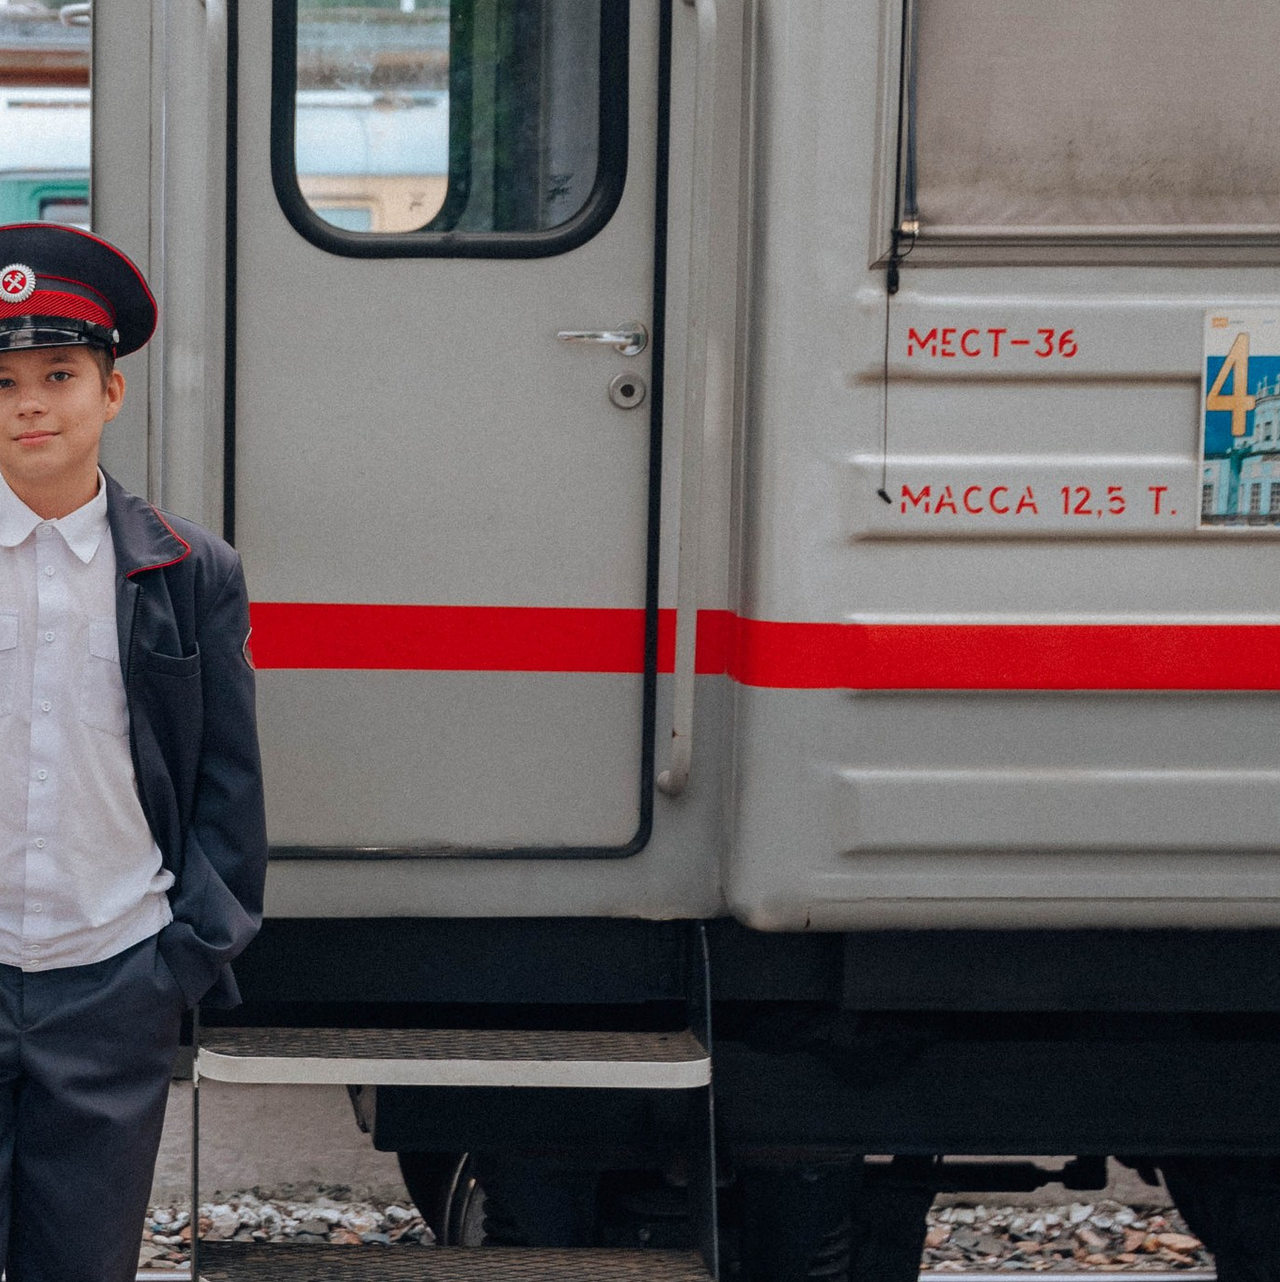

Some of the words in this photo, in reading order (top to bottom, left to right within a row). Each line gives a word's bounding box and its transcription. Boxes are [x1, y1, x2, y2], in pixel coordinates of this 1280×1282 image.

[906, 327, 1080, 359] МЕСТ-36
[1206, 332, 1257, 438] 4
[900, 484, 1039, 516] МАССА
[1060, 484, 1127, 518] 12,5
